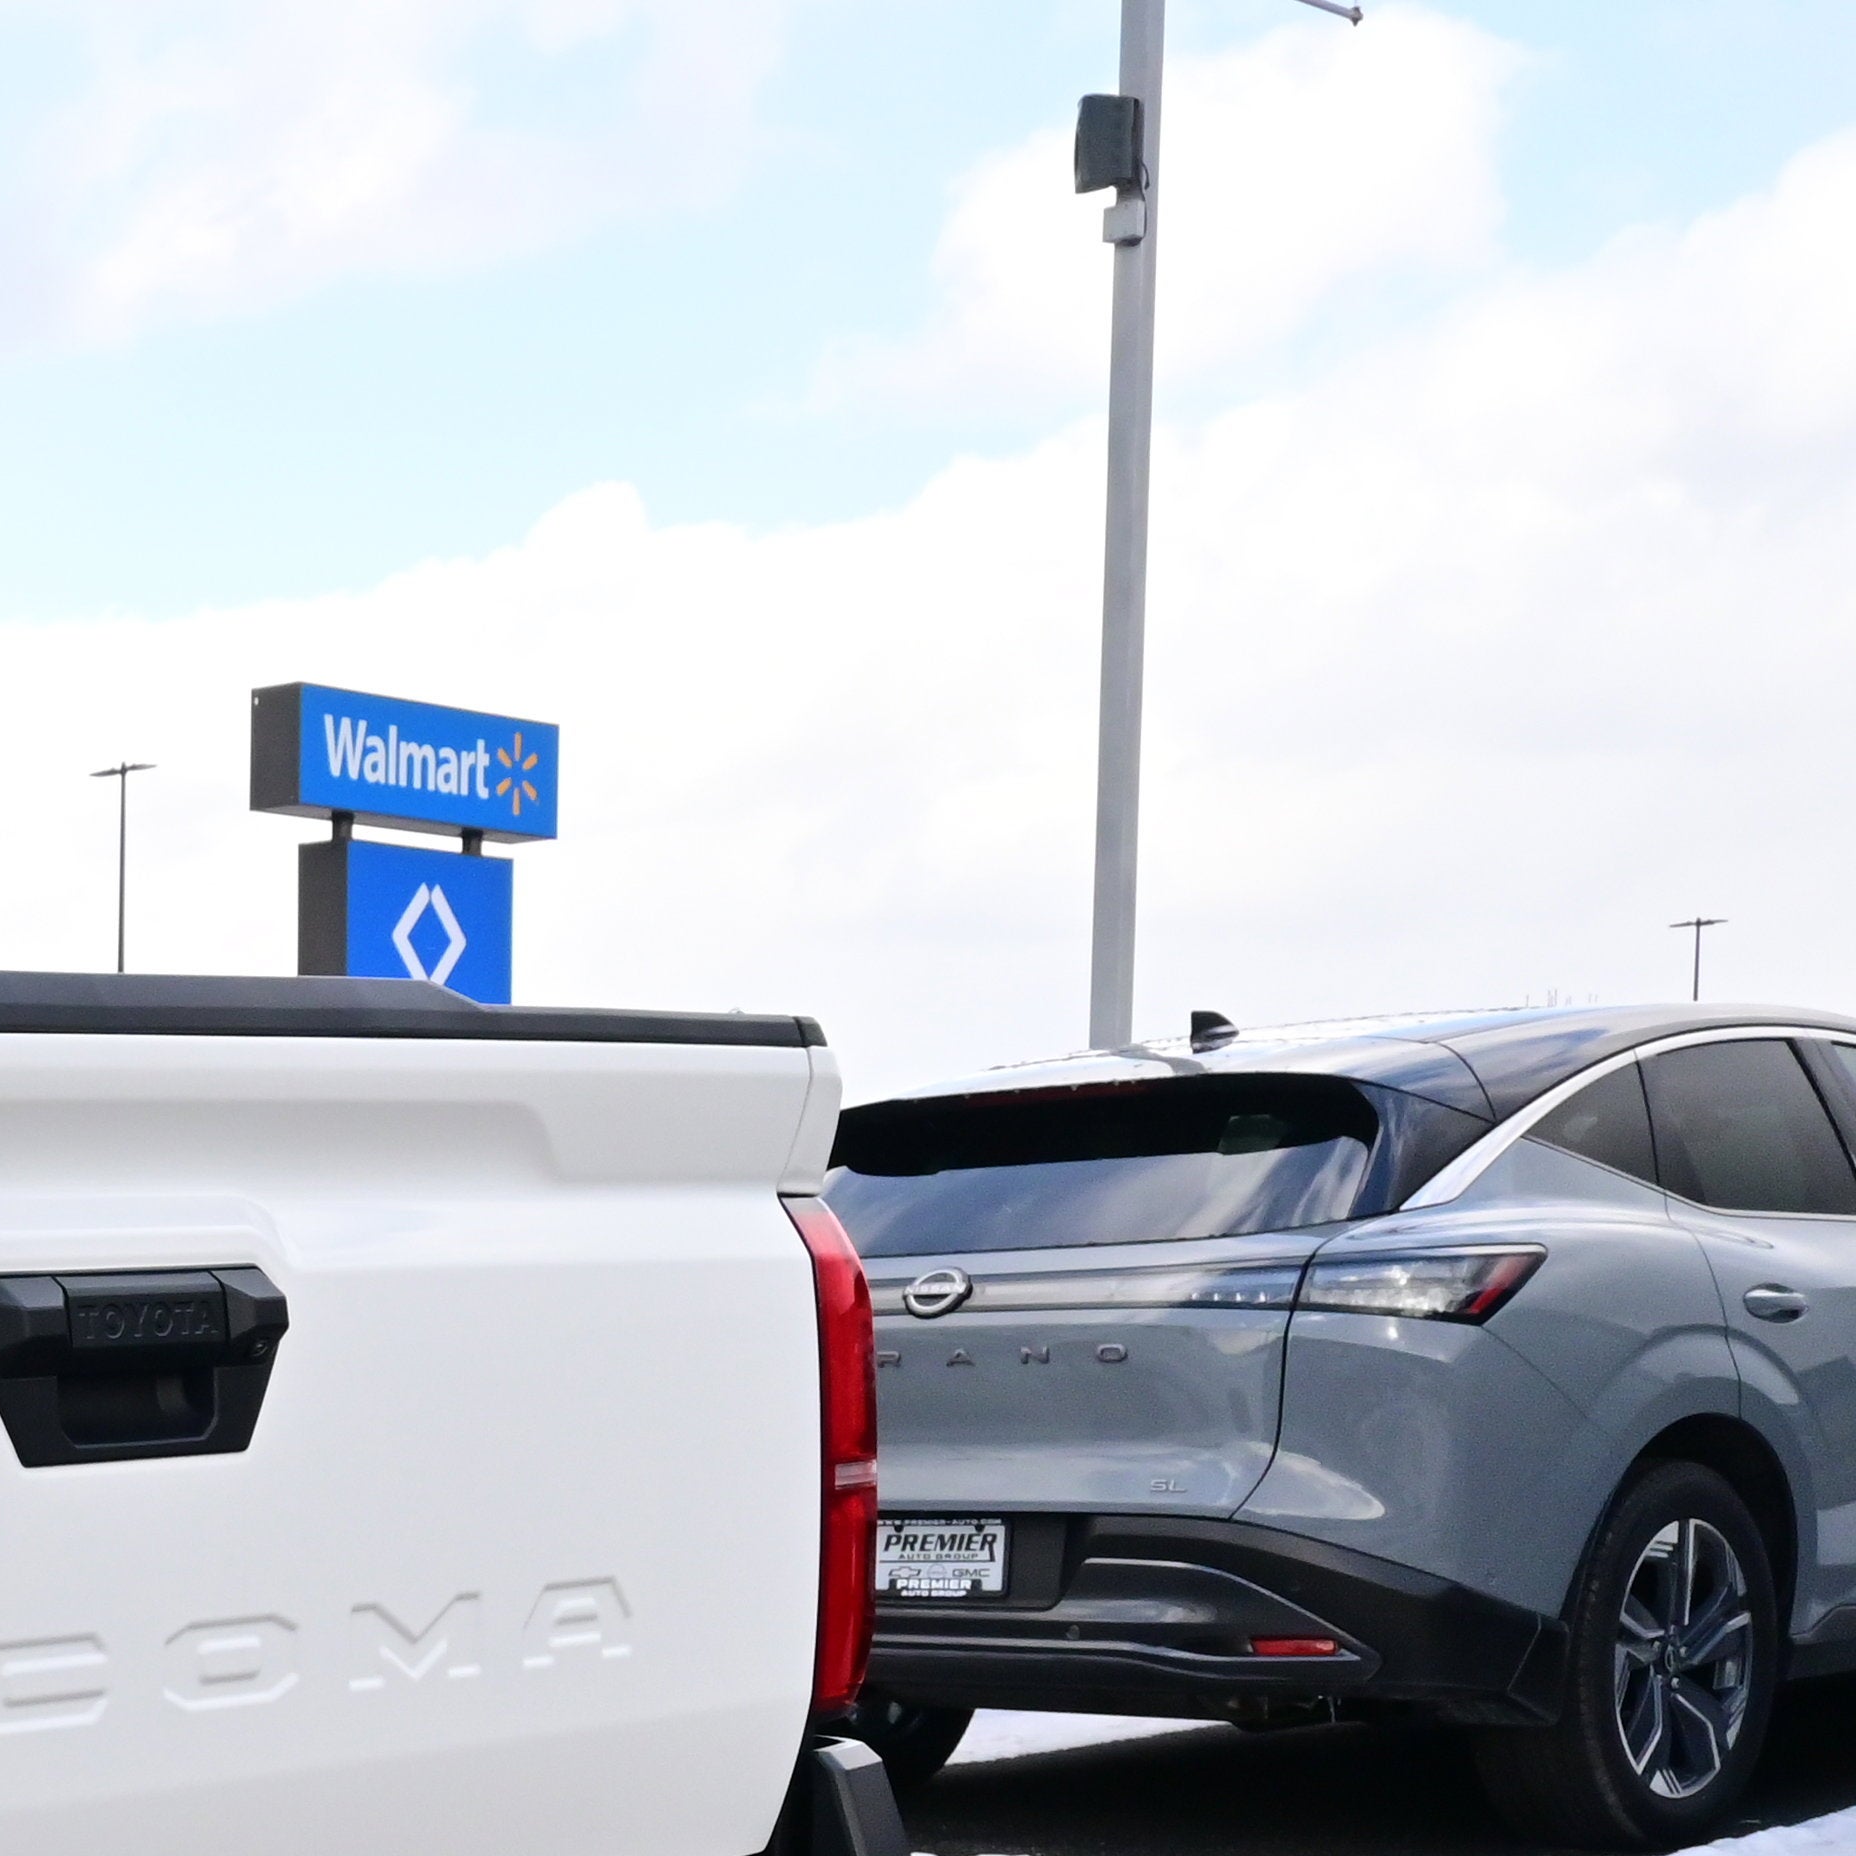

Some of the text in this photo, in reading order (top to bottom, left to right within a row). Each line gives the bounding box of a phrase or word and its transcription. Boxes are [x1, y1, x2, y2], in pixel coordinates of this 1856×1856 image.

[324, 713, 489, 800] Walmart
[904, 1281, 967, 1294] NISSAN
[75, 1301, 219, 1340] TOYOTA
[877, 1343, 1129, 1369] RANO
[1149, 1478, 1188, 1493] SL
[884, 1533, 997, 1562] PREMIER
[952, 1568, 991, 1578] GMC
[896, 1579, 972, 1590] PREMIER
